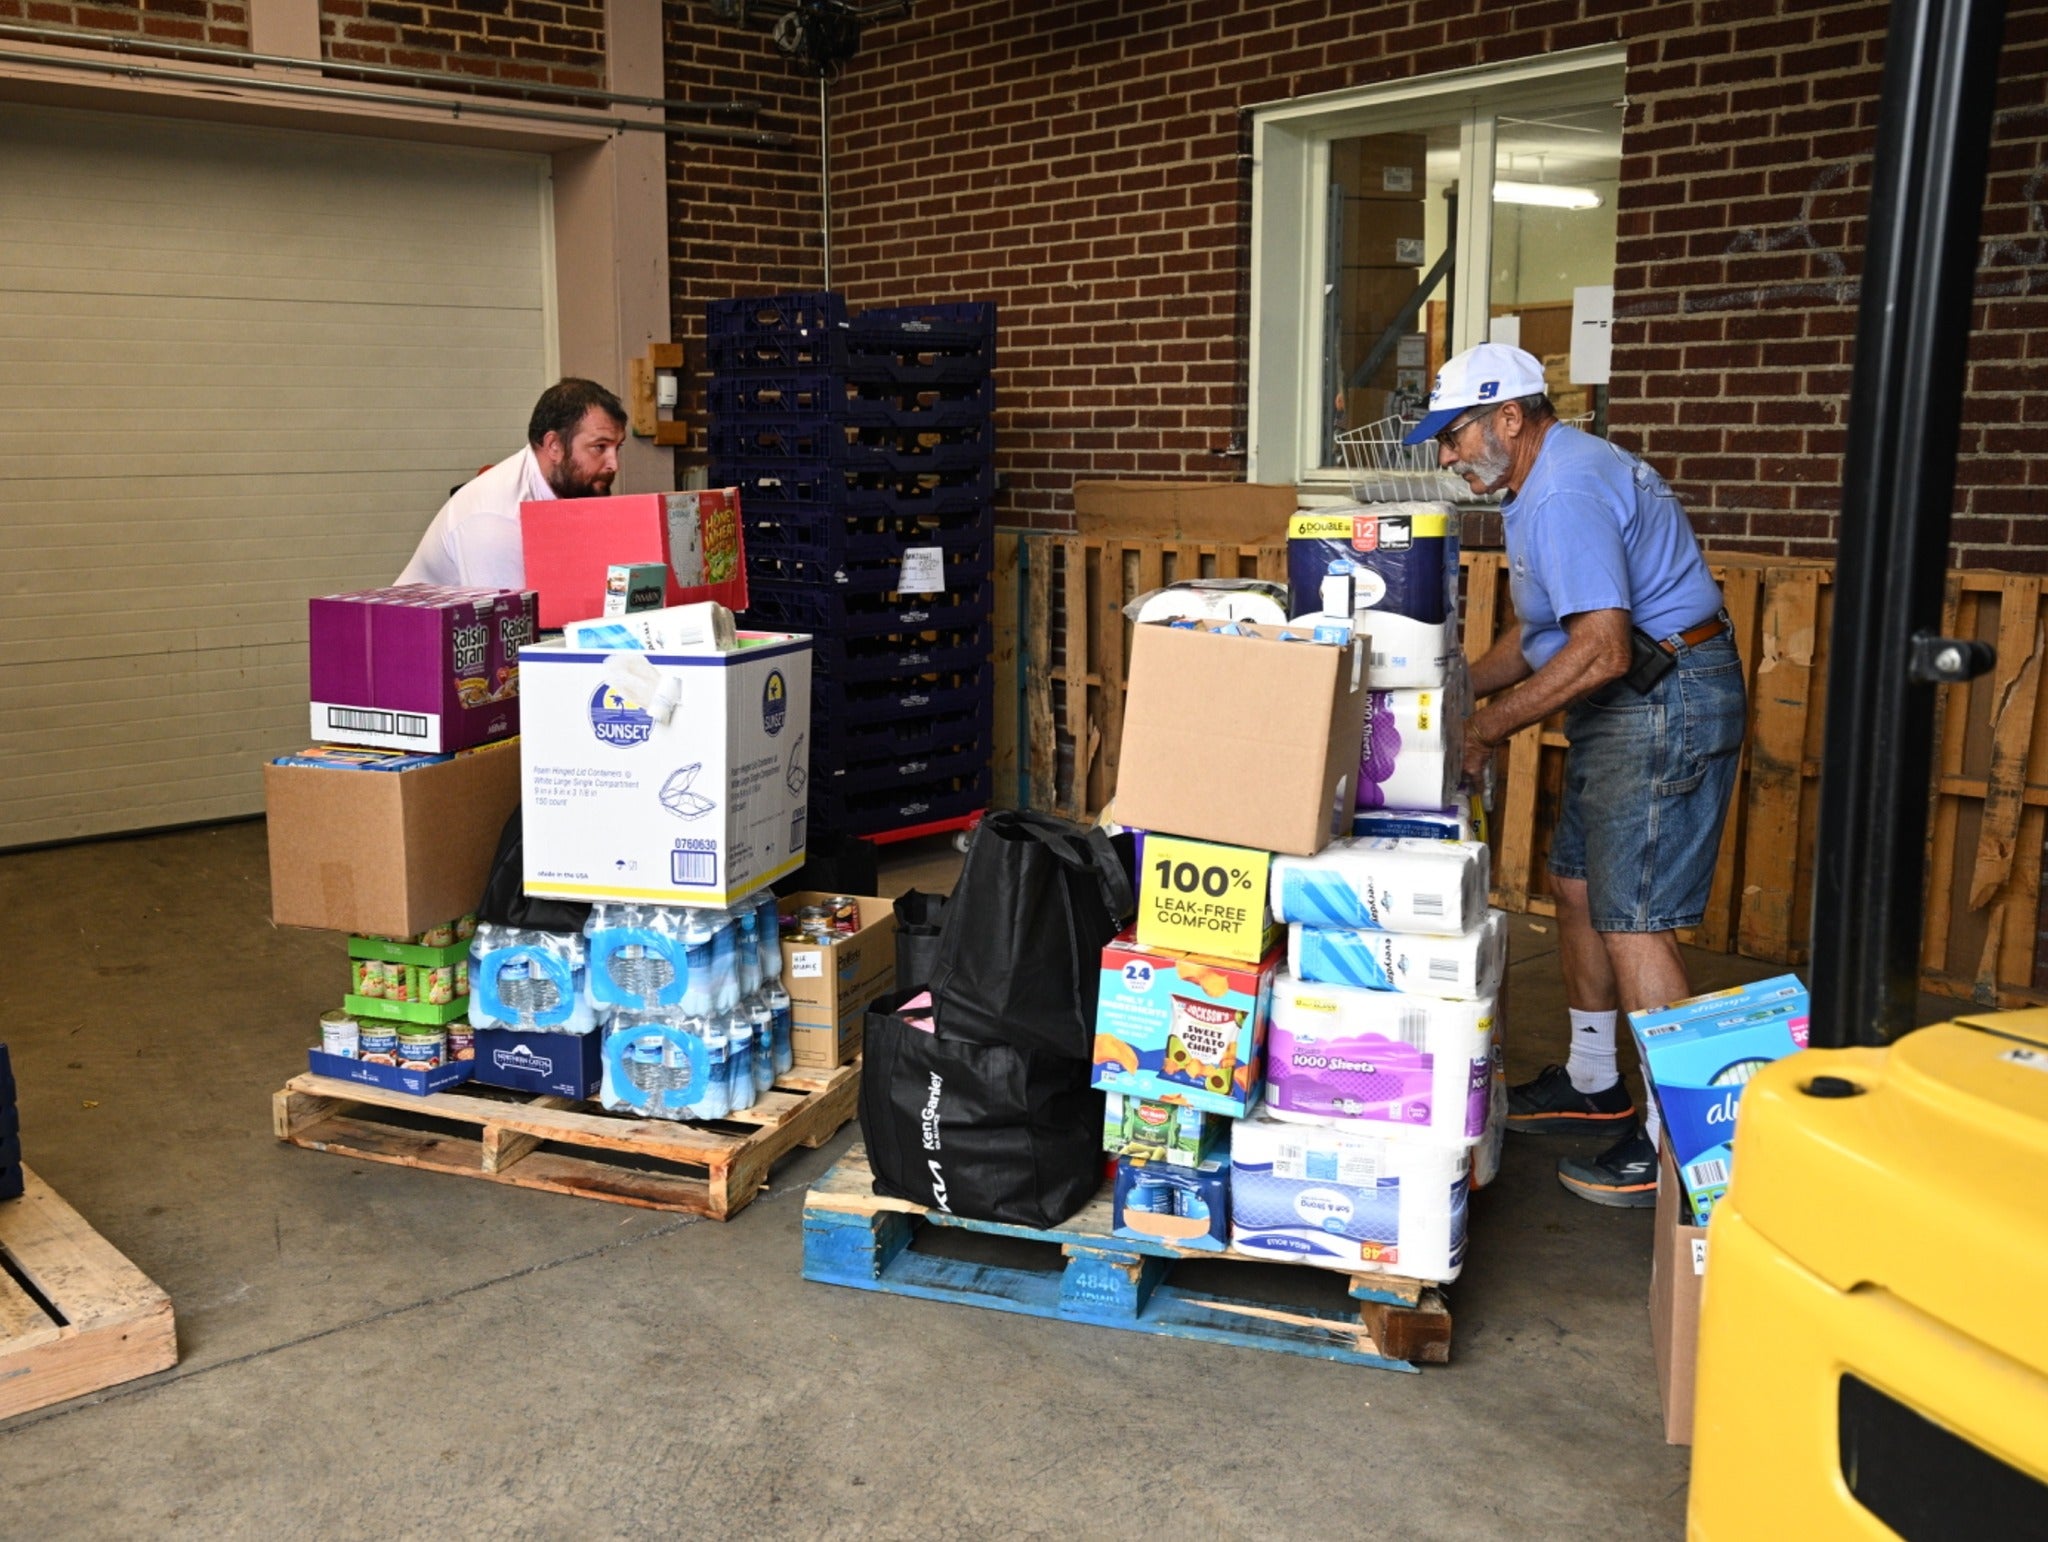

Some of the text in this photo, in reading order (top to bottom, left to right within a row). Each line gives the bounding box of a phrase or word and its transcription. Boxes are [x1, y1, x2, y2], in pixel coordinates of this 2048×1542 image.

[1478, 381, 1500, 400] 9
[1298, 522, 1343, 535] 6 DOUBLE
[1355, 523, 1375, 538] 12
[501, 615, 531, 640] Raisin
[453, 624, 488, 650] Raisin
[455, 647, 485, 672] Bran
[597, 722, 650, 740] SUNSET
[674, 837, 717, 850] 0760630
[1155, 859, 1252, 898] 100%
[1155, 896, 1247, 922] LEAK-FREE
[1157, 910, 1242, 934] COMFORT
[1385, 938, 1395, 985] everyday
[1125, 965, 1150, 981] 24
[1182, 1032, 1225, 1049] POTATO
[1187, 1025, 1224, 1040] SWEET
[1187, 1043, 1218, 1056] CHIPS
[1293, 1054, 1376, 1073] 1000 Sheets
[921, 1070, 943, 1151] Ken Ganley
[1300, 1199, 1350, 1213] Soft & Strong
[1266, 1238, 1311, 1251] MEGA ROLLS
[1362, 1247, 1380, 1260] 48
[1075, 1272, 1120, 1292] 4840
